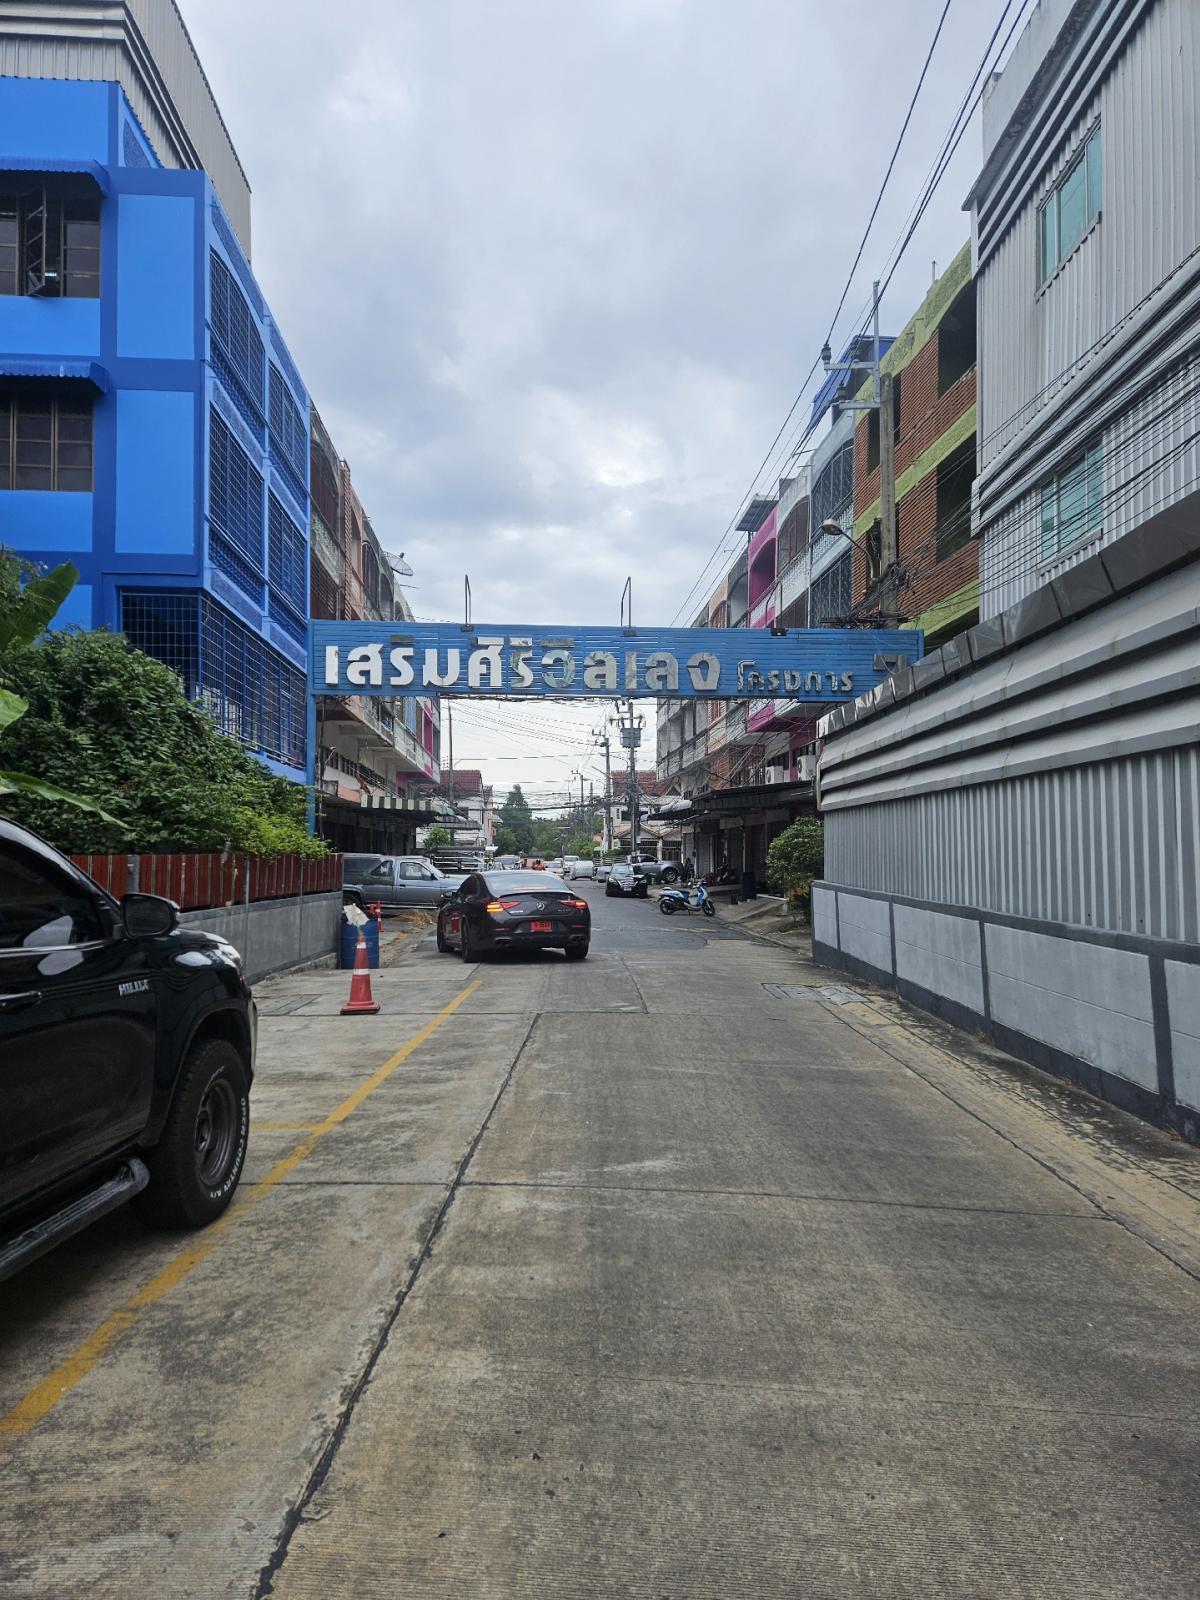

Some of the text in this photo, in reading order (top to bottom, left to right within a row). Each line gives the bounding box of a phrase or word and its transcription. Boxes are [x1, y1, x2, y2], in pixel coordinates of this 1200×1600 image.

[737, 660, 854, 692] โครงการ
[118, 978, 149, 996] HILUX
